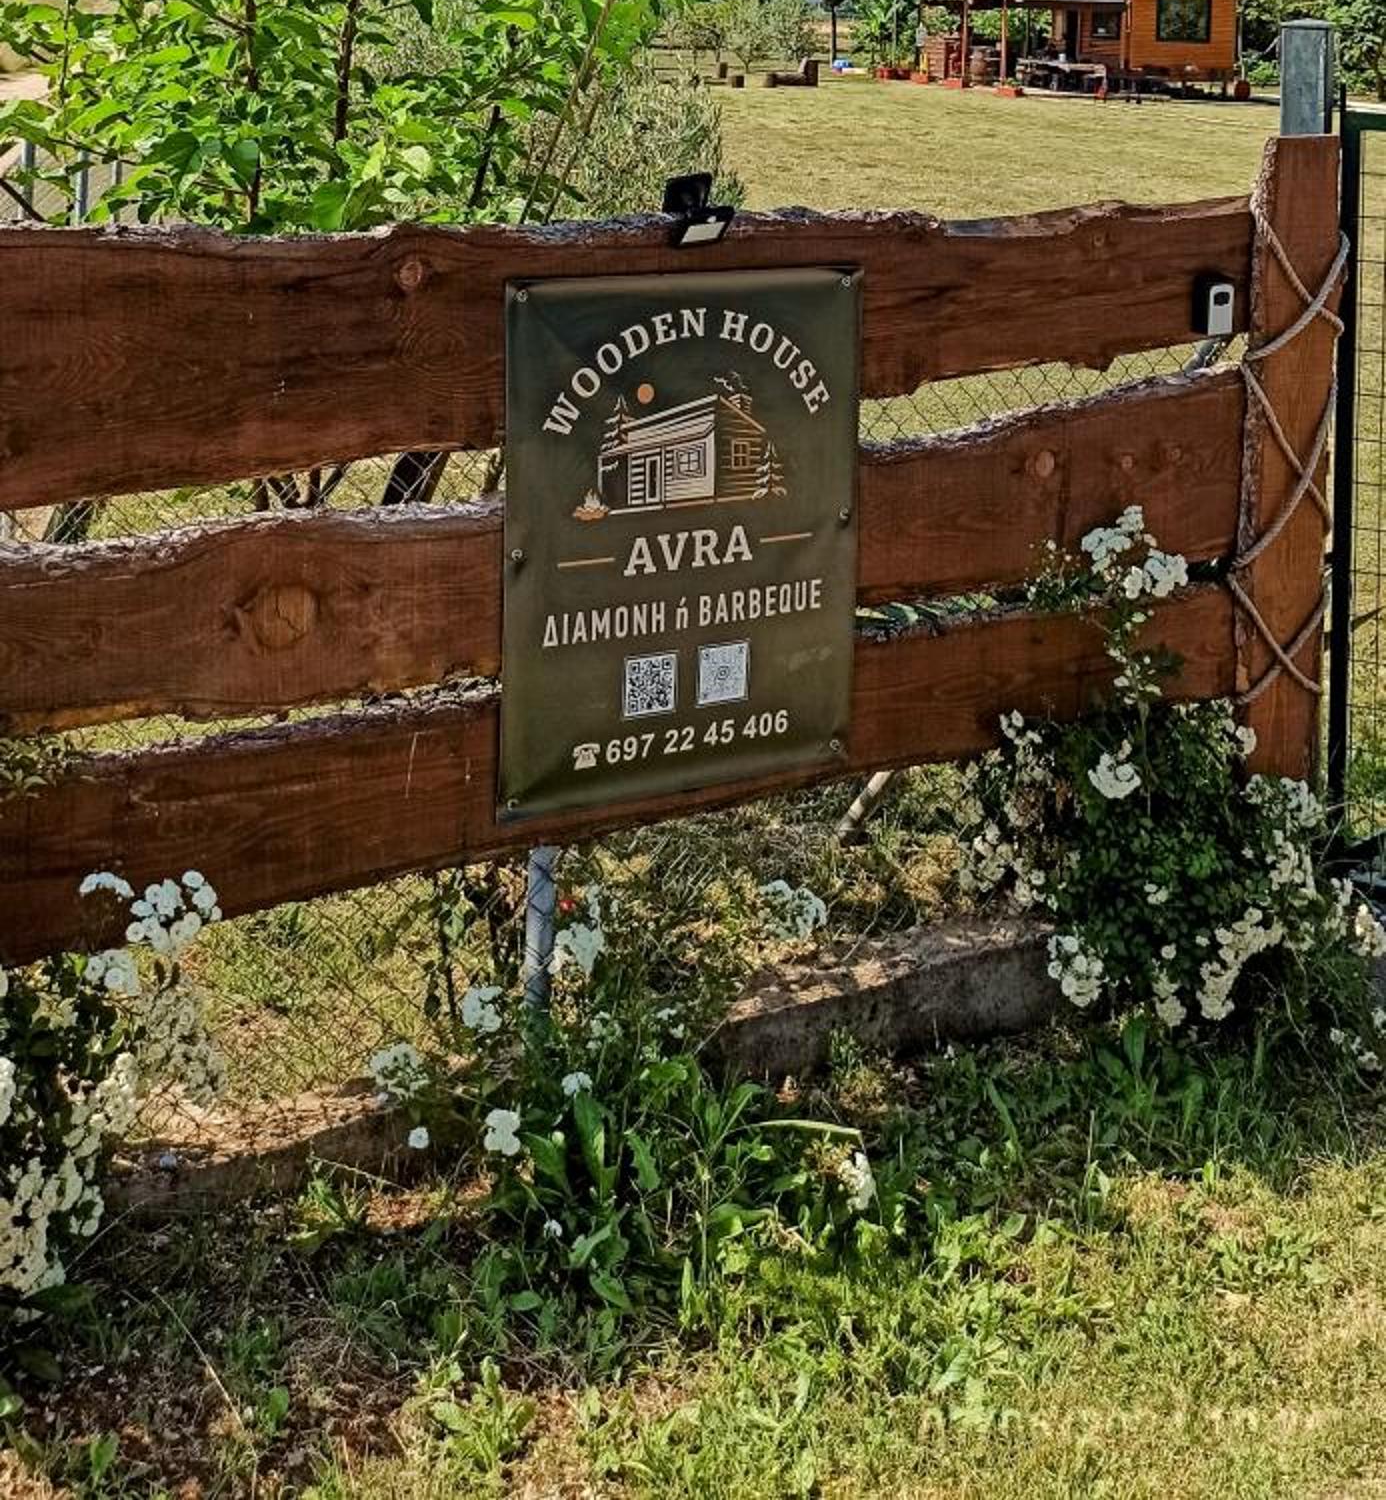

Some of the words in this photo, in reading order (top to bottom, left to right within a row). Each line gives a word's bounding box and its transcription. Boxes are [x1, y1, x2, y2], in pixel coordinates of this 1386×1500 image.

[542, 307, 707, 435] WOODEN
[720, 309, 831, 414] HOUSE
[623, 525, 753, 577] AVRA
[542, 601, 665, 648] ΔΙΑΜΟΝΗ
[698, 578, 823, 627] BARBEQUE
[605, 732, 656, 765] 697
[663, 726, 696, 756] 22
[703, 719, 736, 747] 45
[741, 709, 790, 740] 406
